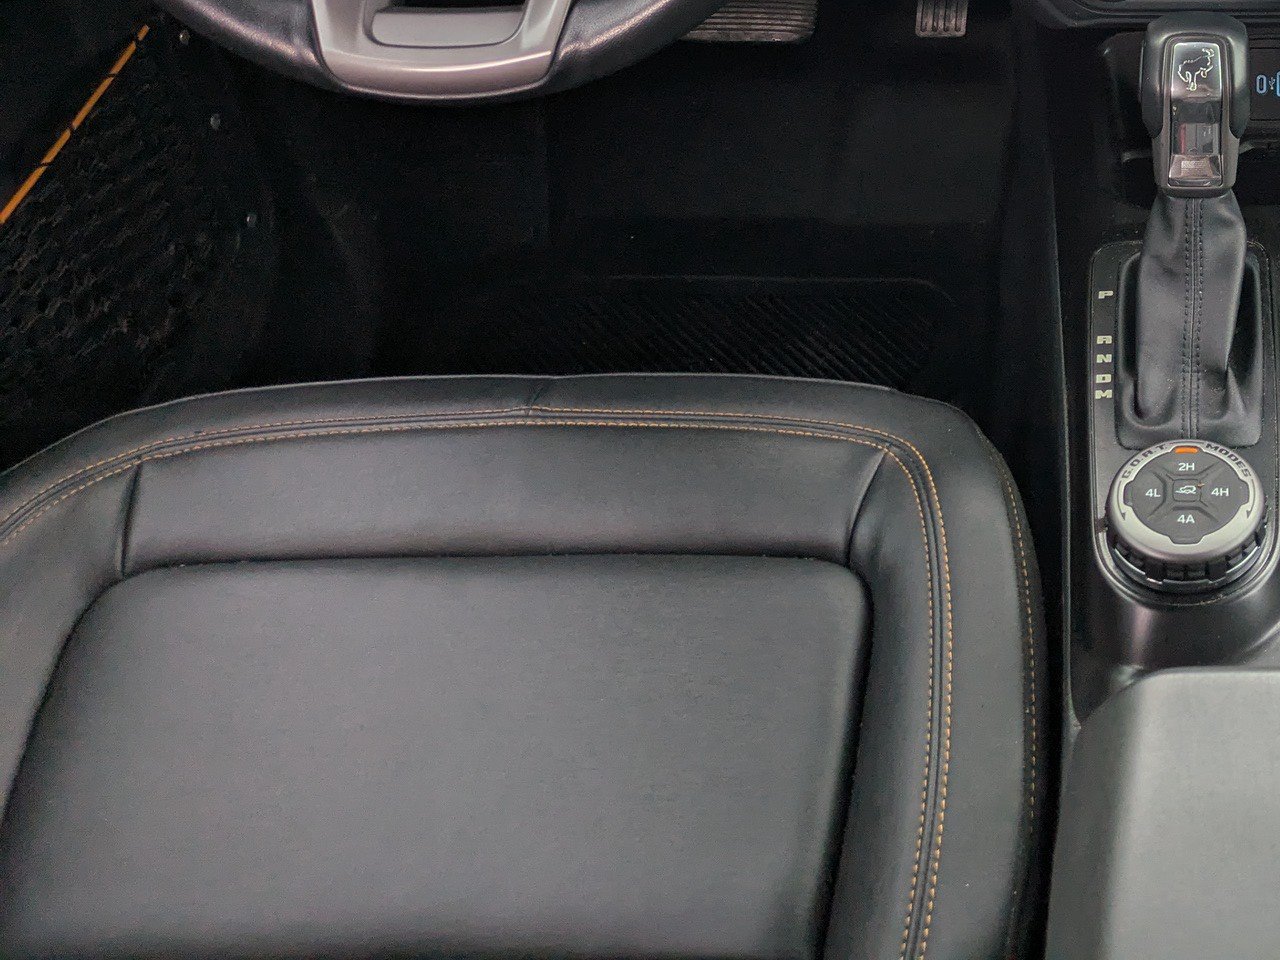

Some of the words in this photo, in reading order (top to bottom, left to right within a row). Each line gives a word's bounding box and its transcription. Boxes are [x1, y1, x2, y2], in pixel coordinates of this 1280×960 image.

[1098, 290, 1114, 299] P
[1096, 353, 1113, 363] N
[1094, 389, 1113, 400] M
[1205, 443, 1252, 478] MODES
[1178, 462, 1195, 471] 2H
[1145, 488, 1161, 498] 4L
[1211, 487, 1229, 497] 4H
[1177, 514, 1195, 524] 4A
